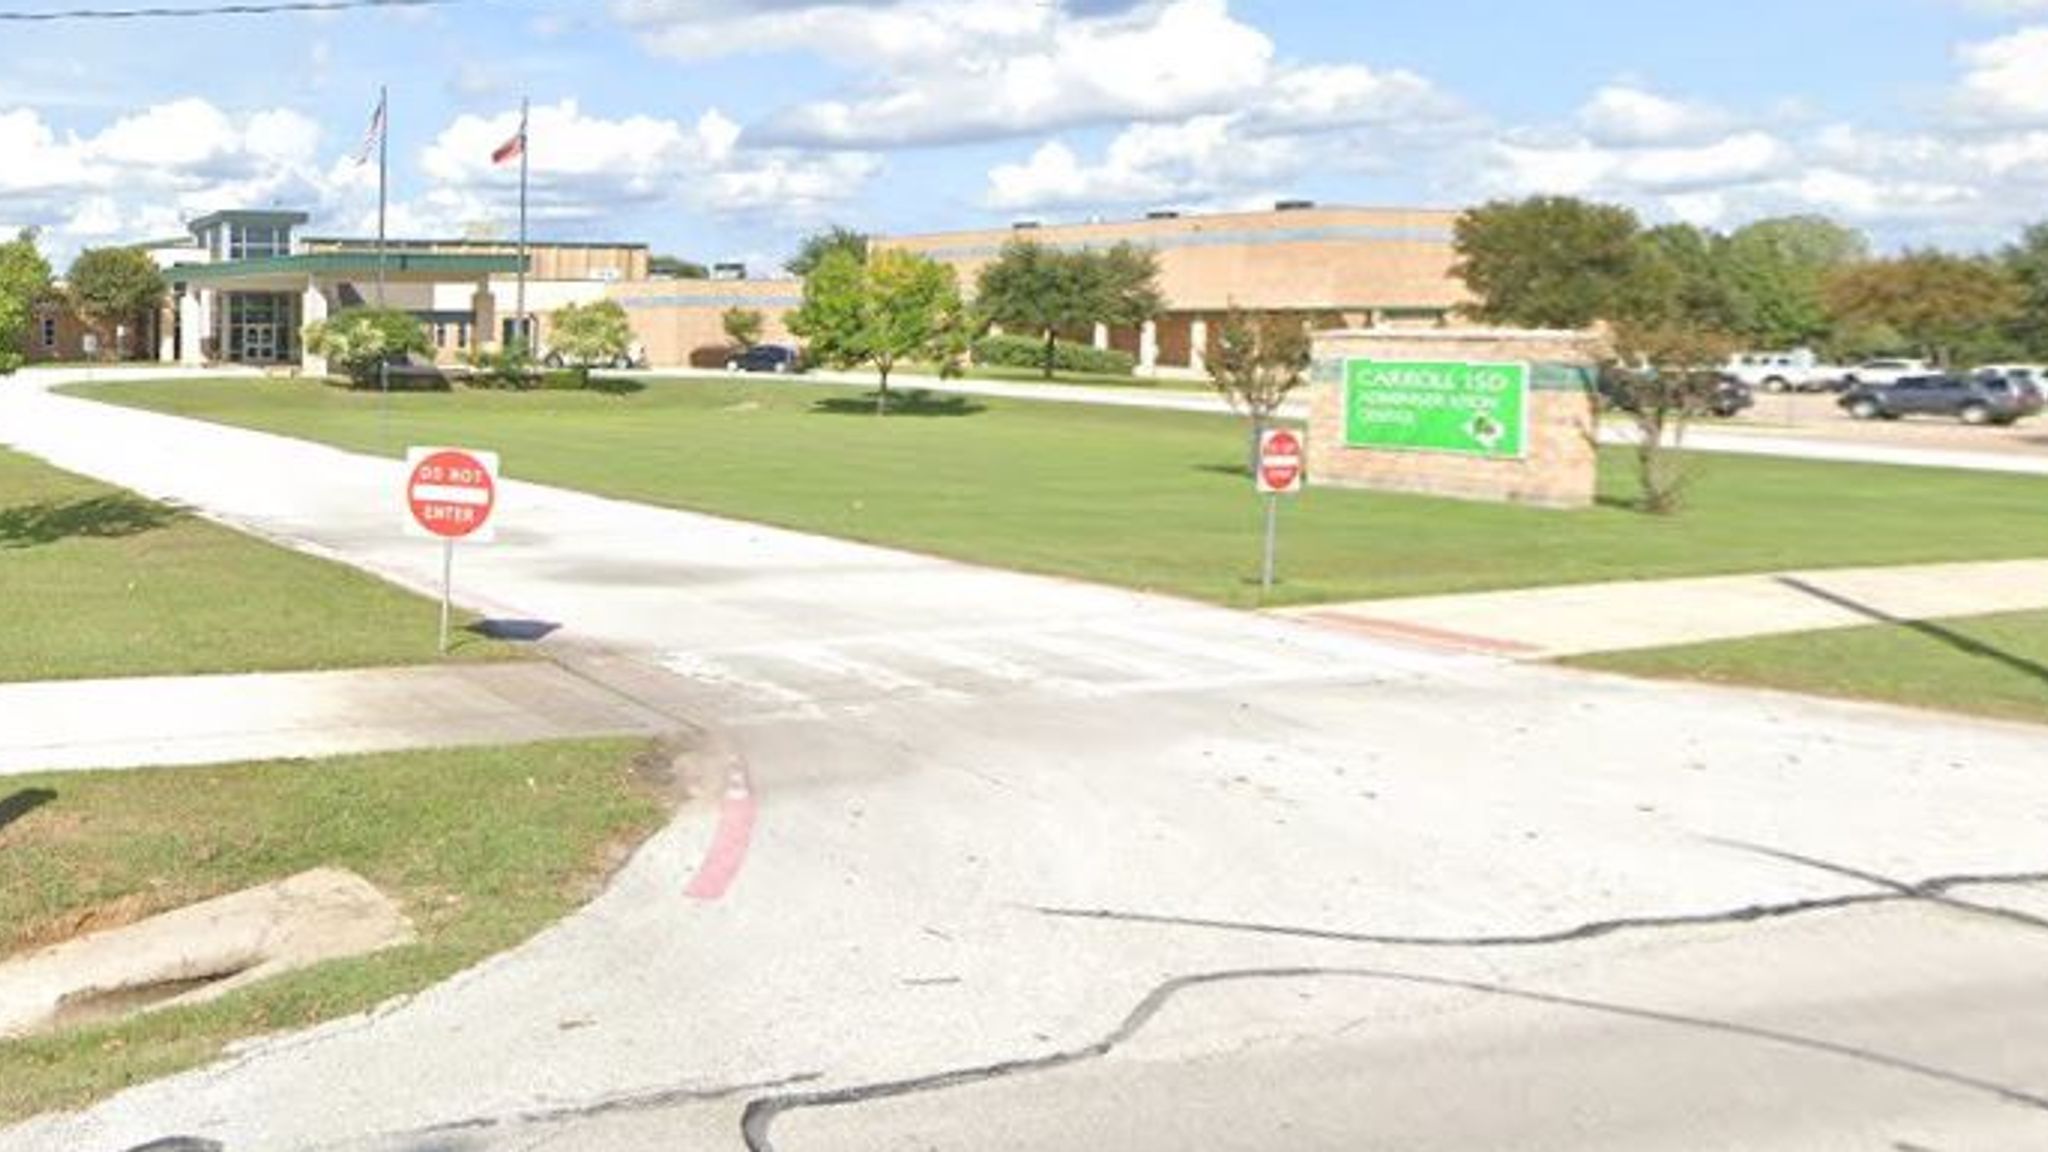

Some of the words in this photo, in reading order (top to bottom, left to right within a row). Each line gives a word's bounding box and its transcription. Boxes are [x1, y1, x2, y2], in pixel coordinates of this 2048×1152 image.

[1358, 369, 1454, 389] CARROLL
[1466, 372, 1508, 392] ISD
[421, 467, 443, 481] DO
[448, 467, 482, 484] NOT
[425, 505, 473, 522] ENTER
